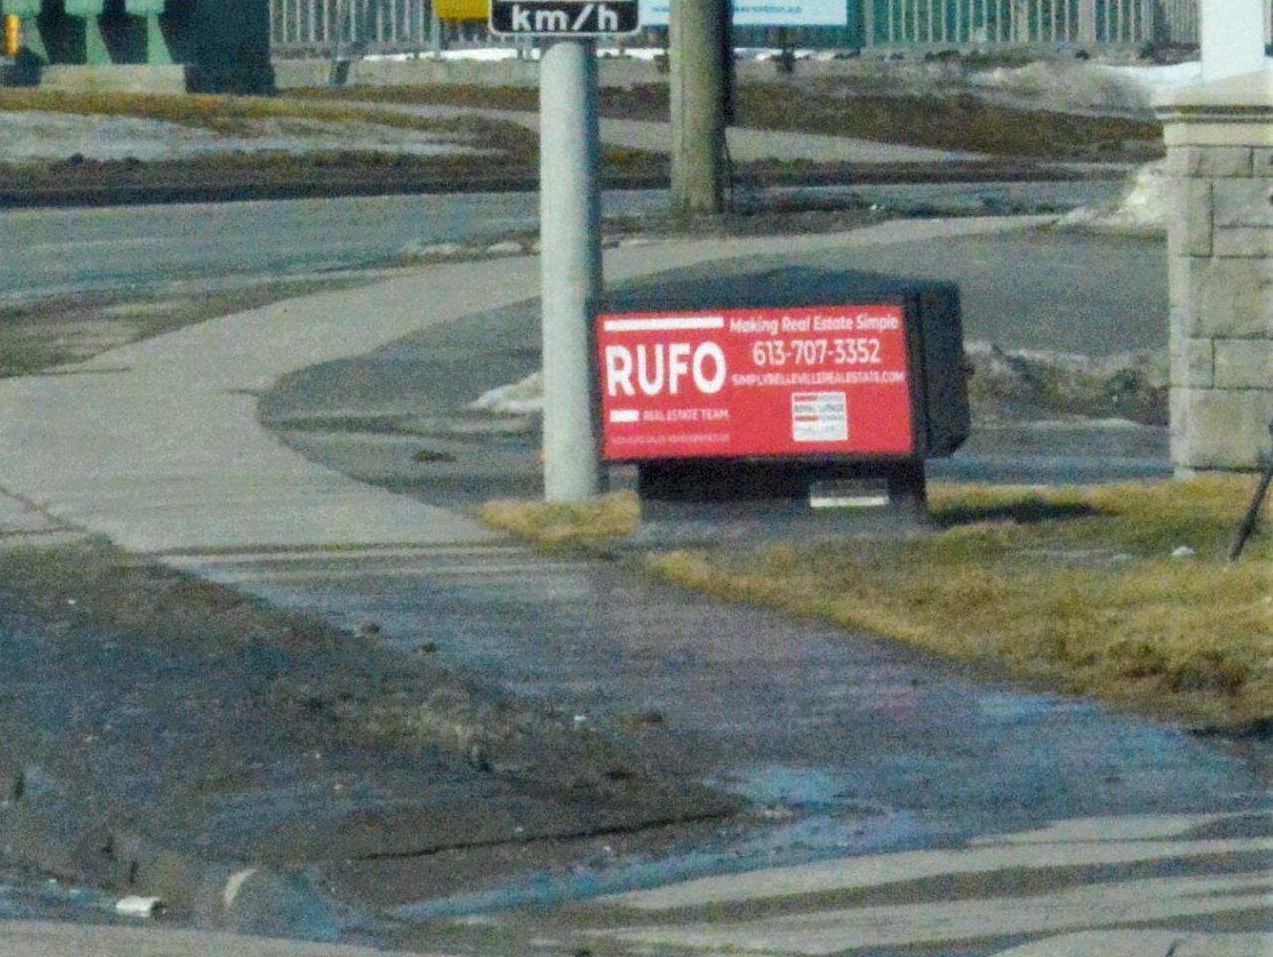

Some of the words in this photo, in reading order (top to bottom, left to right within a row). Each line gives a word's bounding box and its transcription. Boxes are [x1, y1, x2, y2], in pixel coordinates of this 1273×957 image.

[511, 2, 619, 32] km/h
[729, 318, 779, 335] Making
[782, 316, 810, 331] Real
[813, 315, 853, 331] Estate
[856, 313, 900, 332] Simple
[752, 338, 882, 365] 613-707-3352
[604, 341, 727, 397] RUFO
